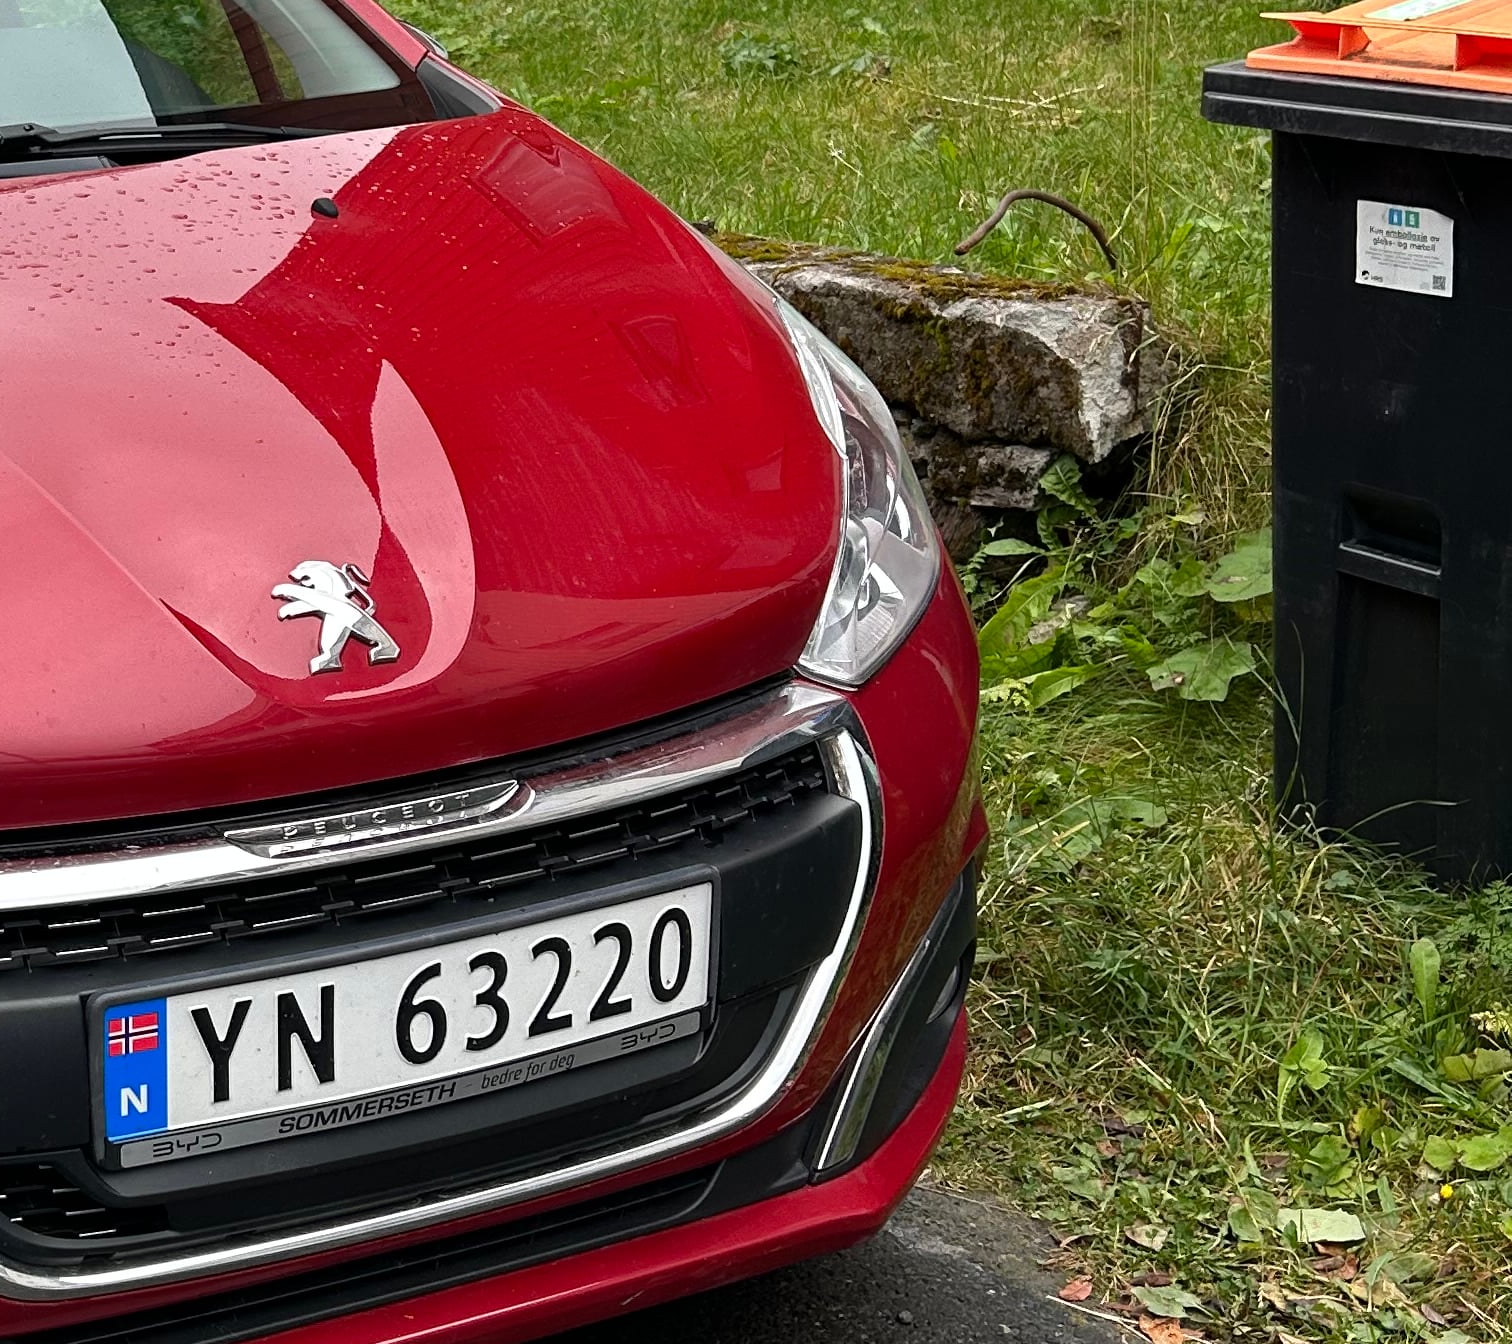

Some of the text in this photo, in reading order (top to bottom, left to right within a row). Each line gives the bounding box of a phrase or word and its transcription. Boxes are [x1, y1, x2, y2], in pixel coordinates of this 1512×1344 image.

[281, 792, 470, 840] PEUGEOT
[189, 906, 693, 1104] YN 63220
[620, 1023, 676, 1050] BYD
[120, 1084, 149, 1117] N
[277, 1081, 458, 1135] SOMMERSETH
[480, 1068, 523, 1089] bedre
[522, 1062, 546, 1083] for
[548, 1052, 576, 1070] deg
[152, 1132, 222, 1158] BYD
